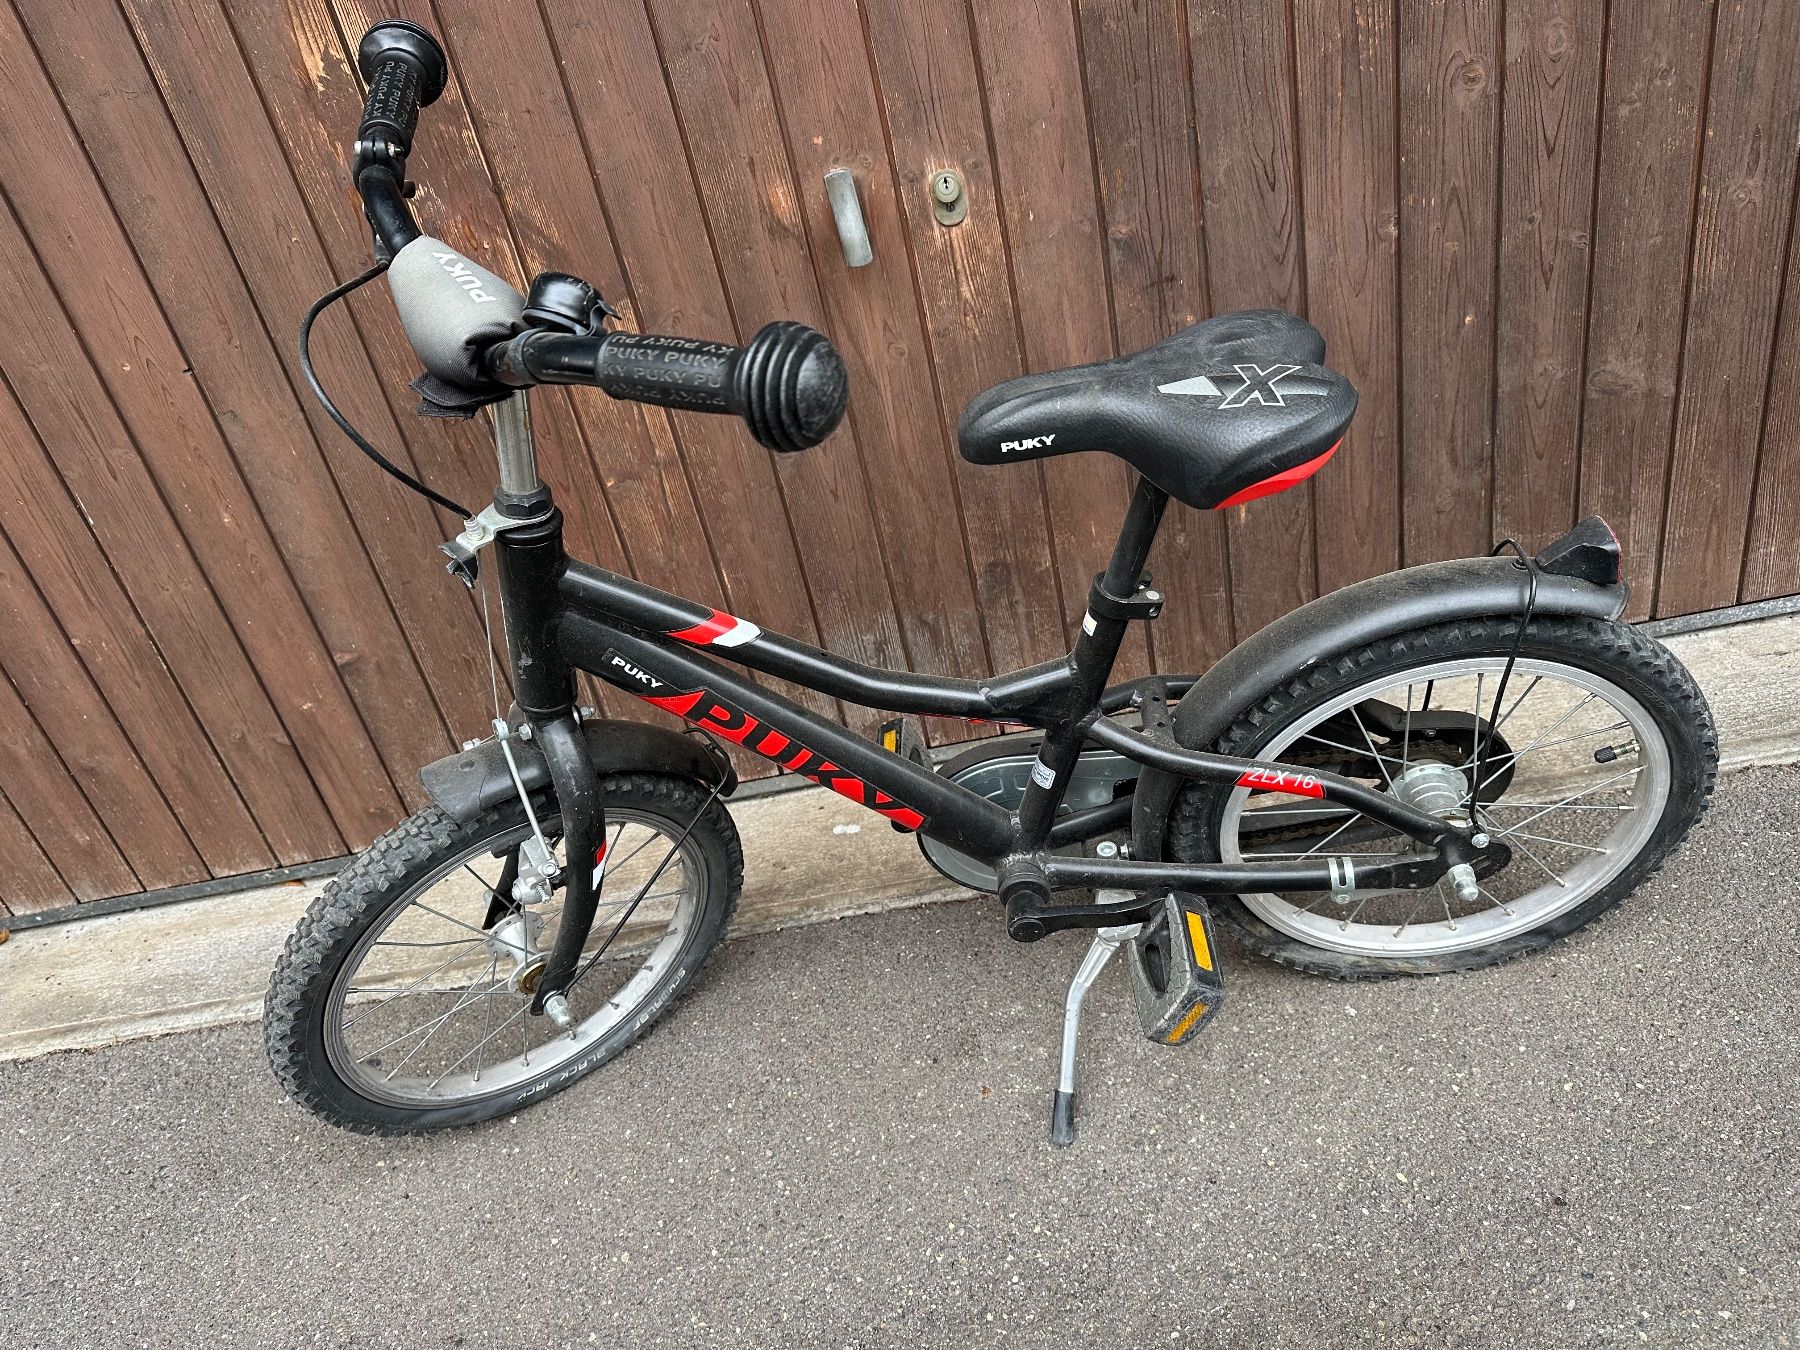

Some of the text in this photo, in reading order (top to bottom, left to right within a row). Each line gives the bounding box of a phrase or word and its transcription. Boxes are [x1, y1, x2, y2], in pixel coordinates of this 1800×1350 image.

[372, 61, 394, 117] KY PUKY PU
[386, 62, 407, 119] PUKY PUKY
[432, 252, 497, 303] PUKY
[612, 335, 639, 344] PU
[643, 337, 700, 349] PUKY
[605, 346, 727, 369] PUKY PUKY
[604, 362, 721, 388] KY PUKY PU
[1217, 363, 1302, 410] X
[1000, 434, 1056, 453] PUKY
[611, 656, 663, 688] PUKY
[686, 691, 923, 824] PUKY
[1248, 767, 1315, 789] ZLX 16
[560, 1048, 606, 1081] BLACK
